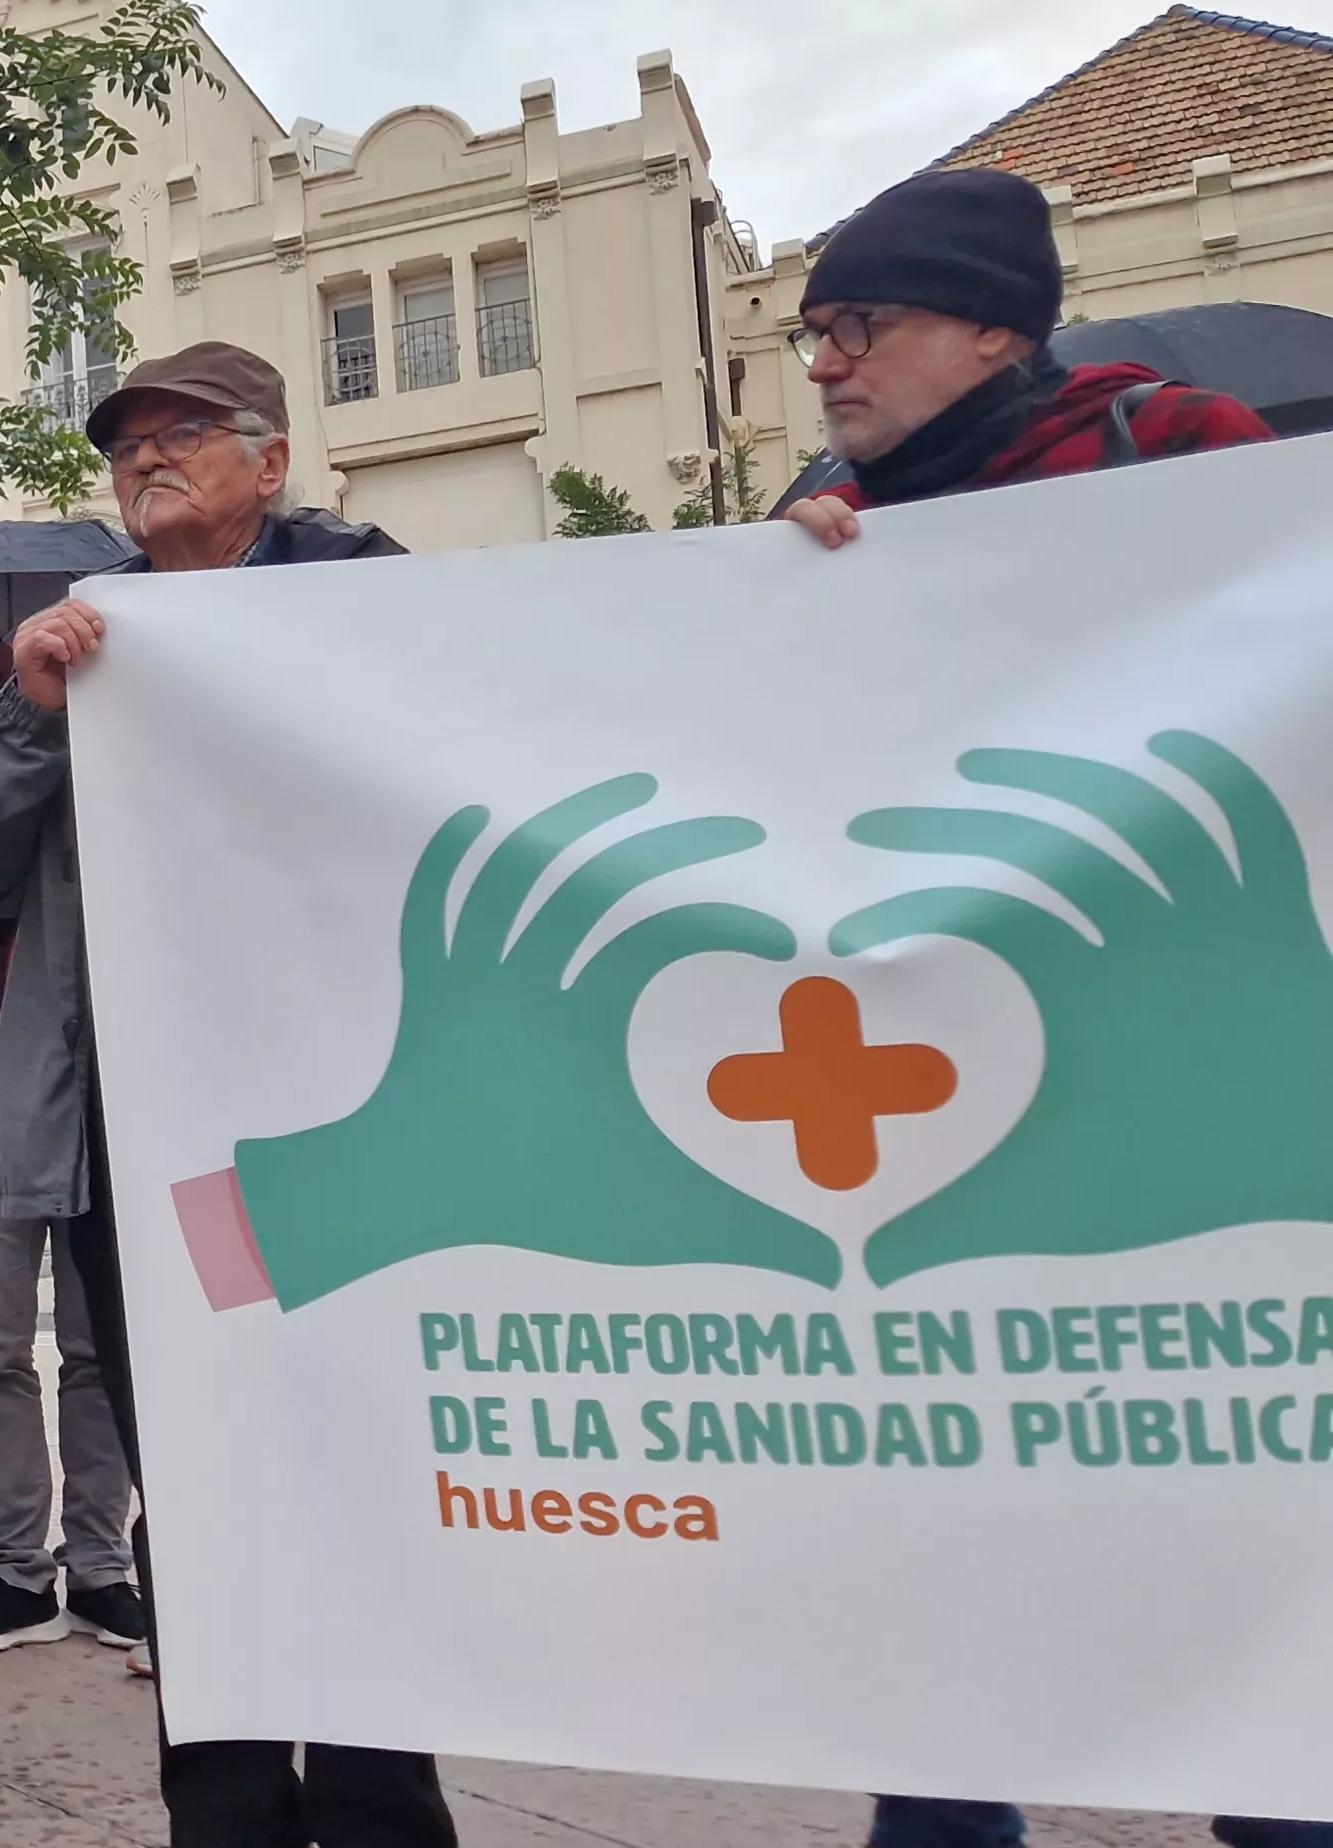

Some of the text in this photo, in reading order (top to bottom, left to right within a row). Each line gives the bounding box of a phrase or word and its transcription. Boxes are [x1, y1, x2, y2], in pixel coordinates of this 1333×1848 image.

[420, 1296, 1333, 1376] PLATAFORMA EN DEFENSA
[429, 1394, 510, 1457] DE
[532, 1398, 618, 1461] LA
[642, 1400, 982, 1468] SANIDAD
[436, 1470, 720, 1541] huesca
